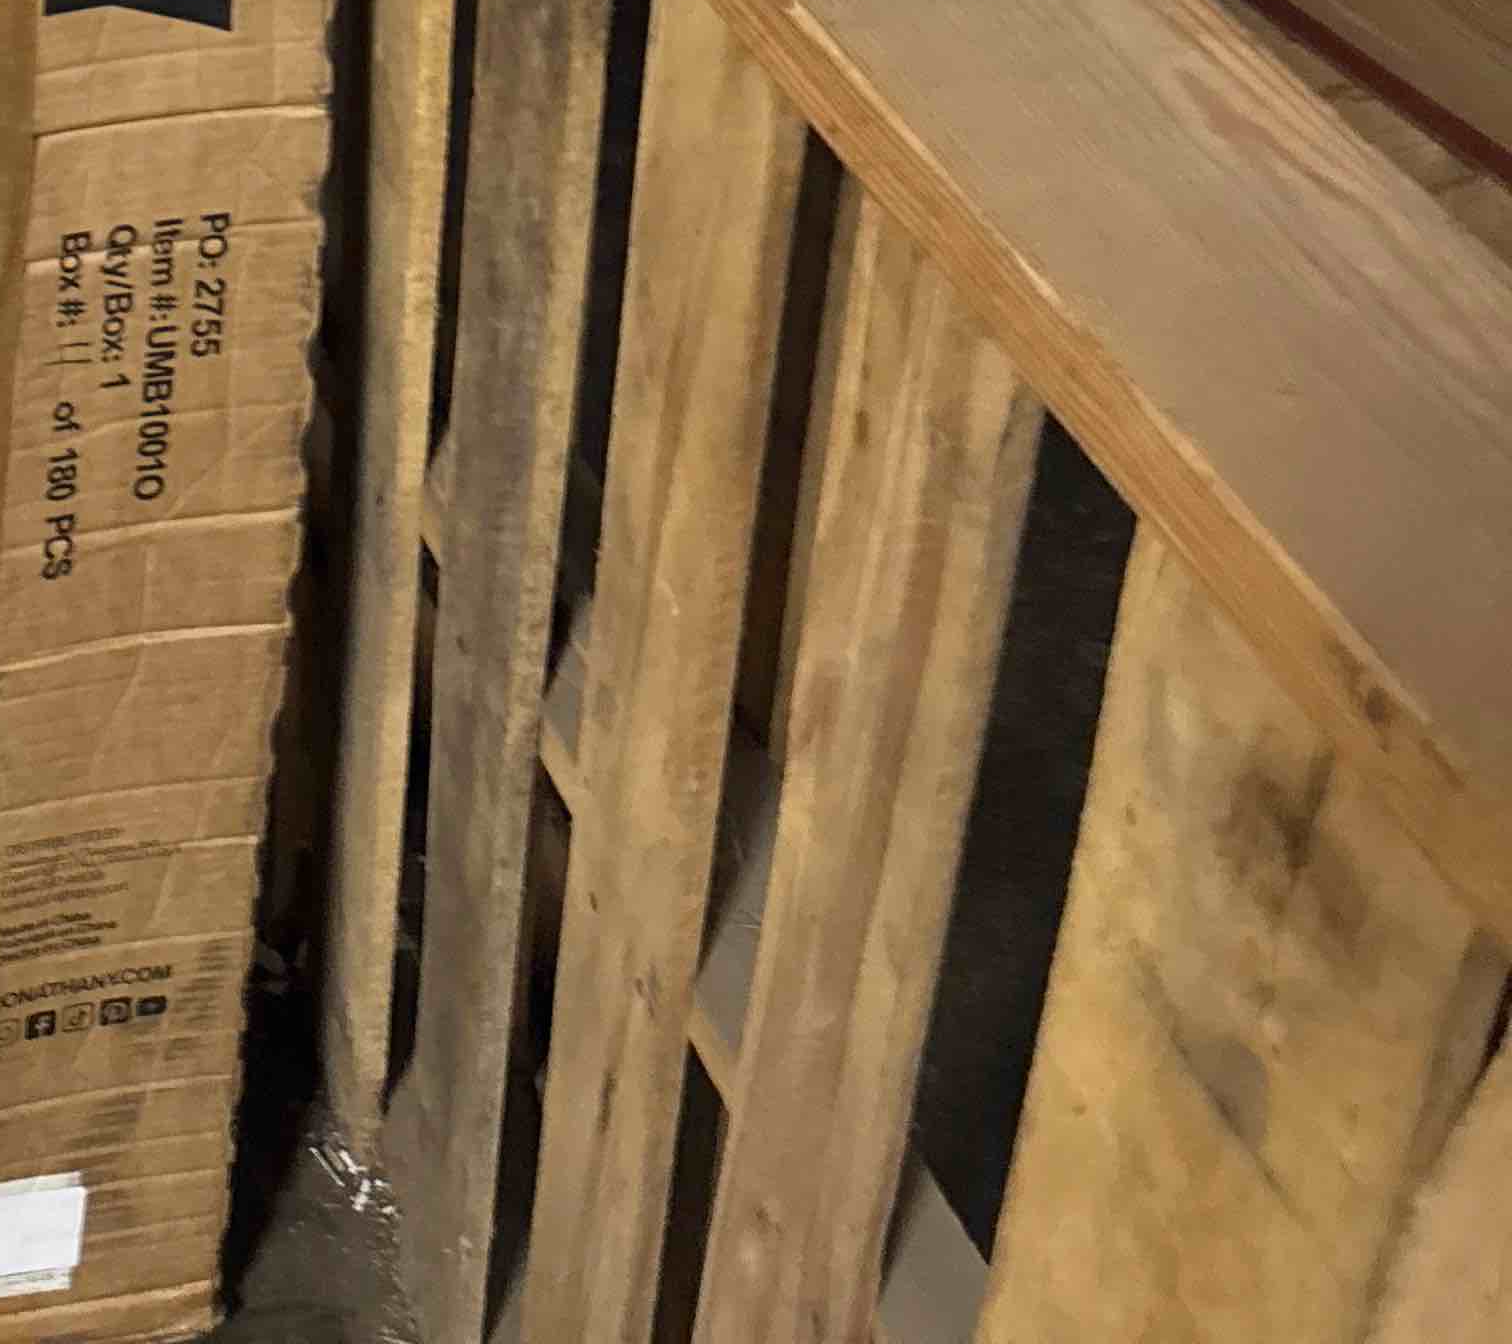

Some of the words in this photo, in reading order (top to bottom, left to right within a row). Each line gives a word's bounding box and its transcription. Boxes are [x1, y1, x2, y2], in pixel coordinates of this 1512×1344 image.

[58, 230, 91, 292] Box
[151, 217, 183, 287] Item
[197, 212, 231, 269] PO:
[99, 223, 138, 363] Qty/Box:
[191, 277, 228, 358] 2755
[99, 372, 132, 391] 1
[53, 400, 81, 434] of
[44, 447, 80, 502] 180
[40, 513, 76, 582] PCS
